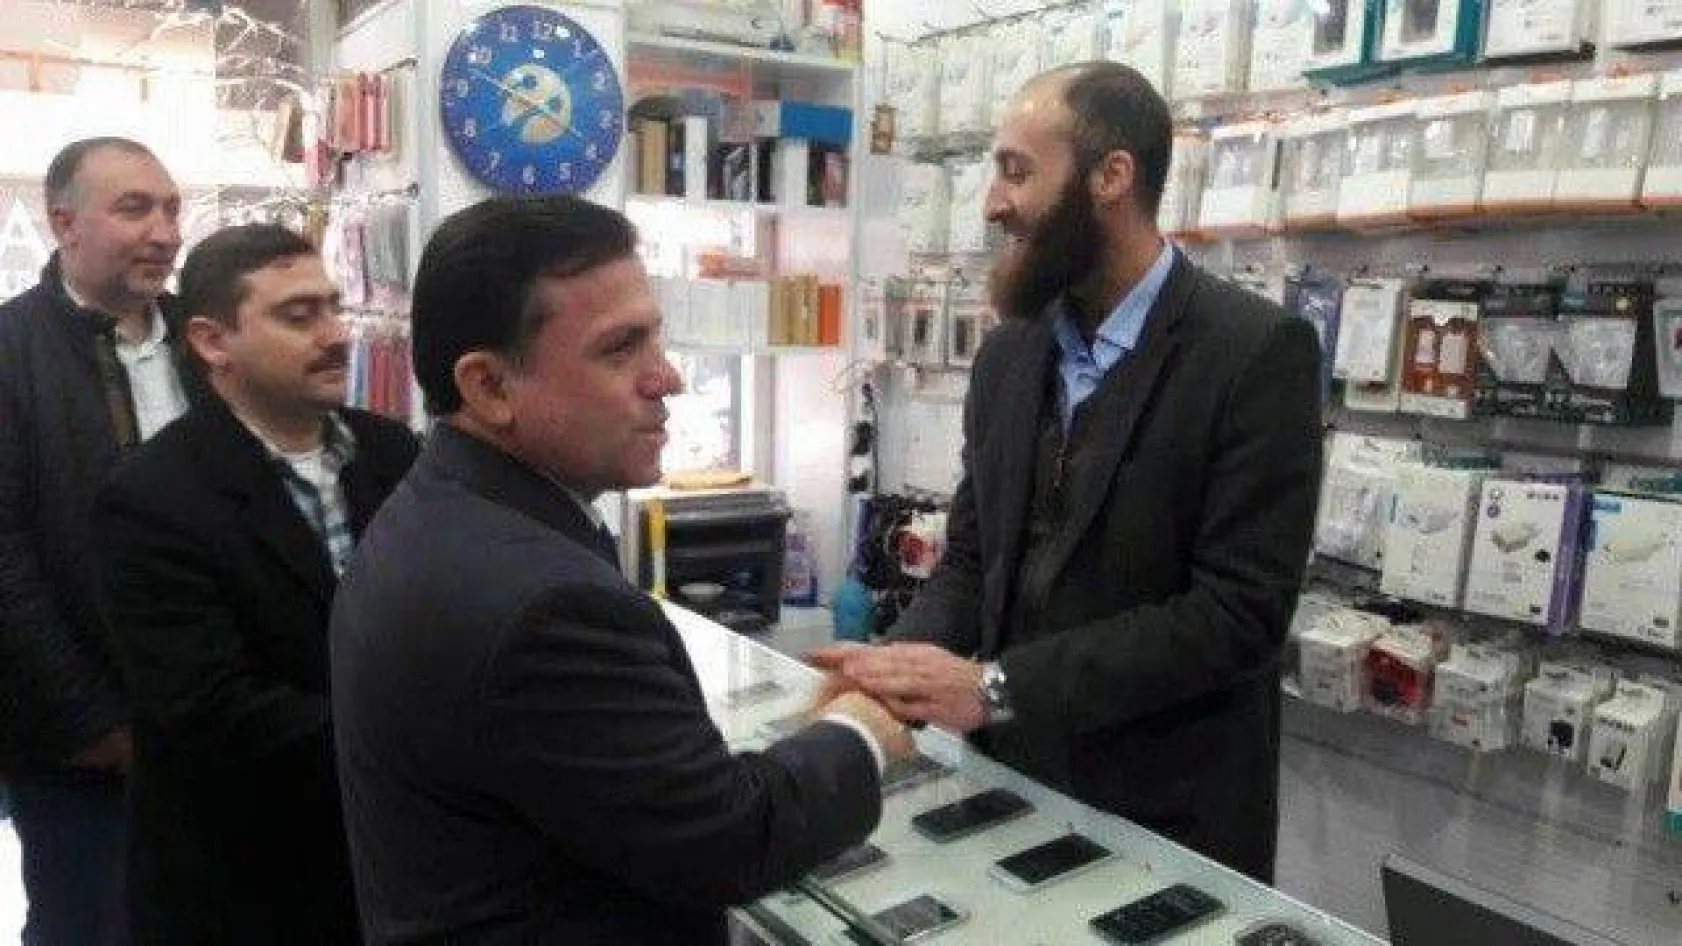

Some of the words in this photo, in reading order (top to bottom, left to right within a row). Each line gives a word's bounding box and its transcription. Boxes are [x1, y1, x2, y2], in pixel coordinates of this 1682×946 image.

[533, 21, 553, 40] 12
[456, 78, 469, 98] 9
[593, 72, 605, 90] 2
[464, 118, 477, 138] 8
[488, 151, 500, 169] 7
[522, 165, 535, 184] 6
[559, 162, 572, 180] 5
